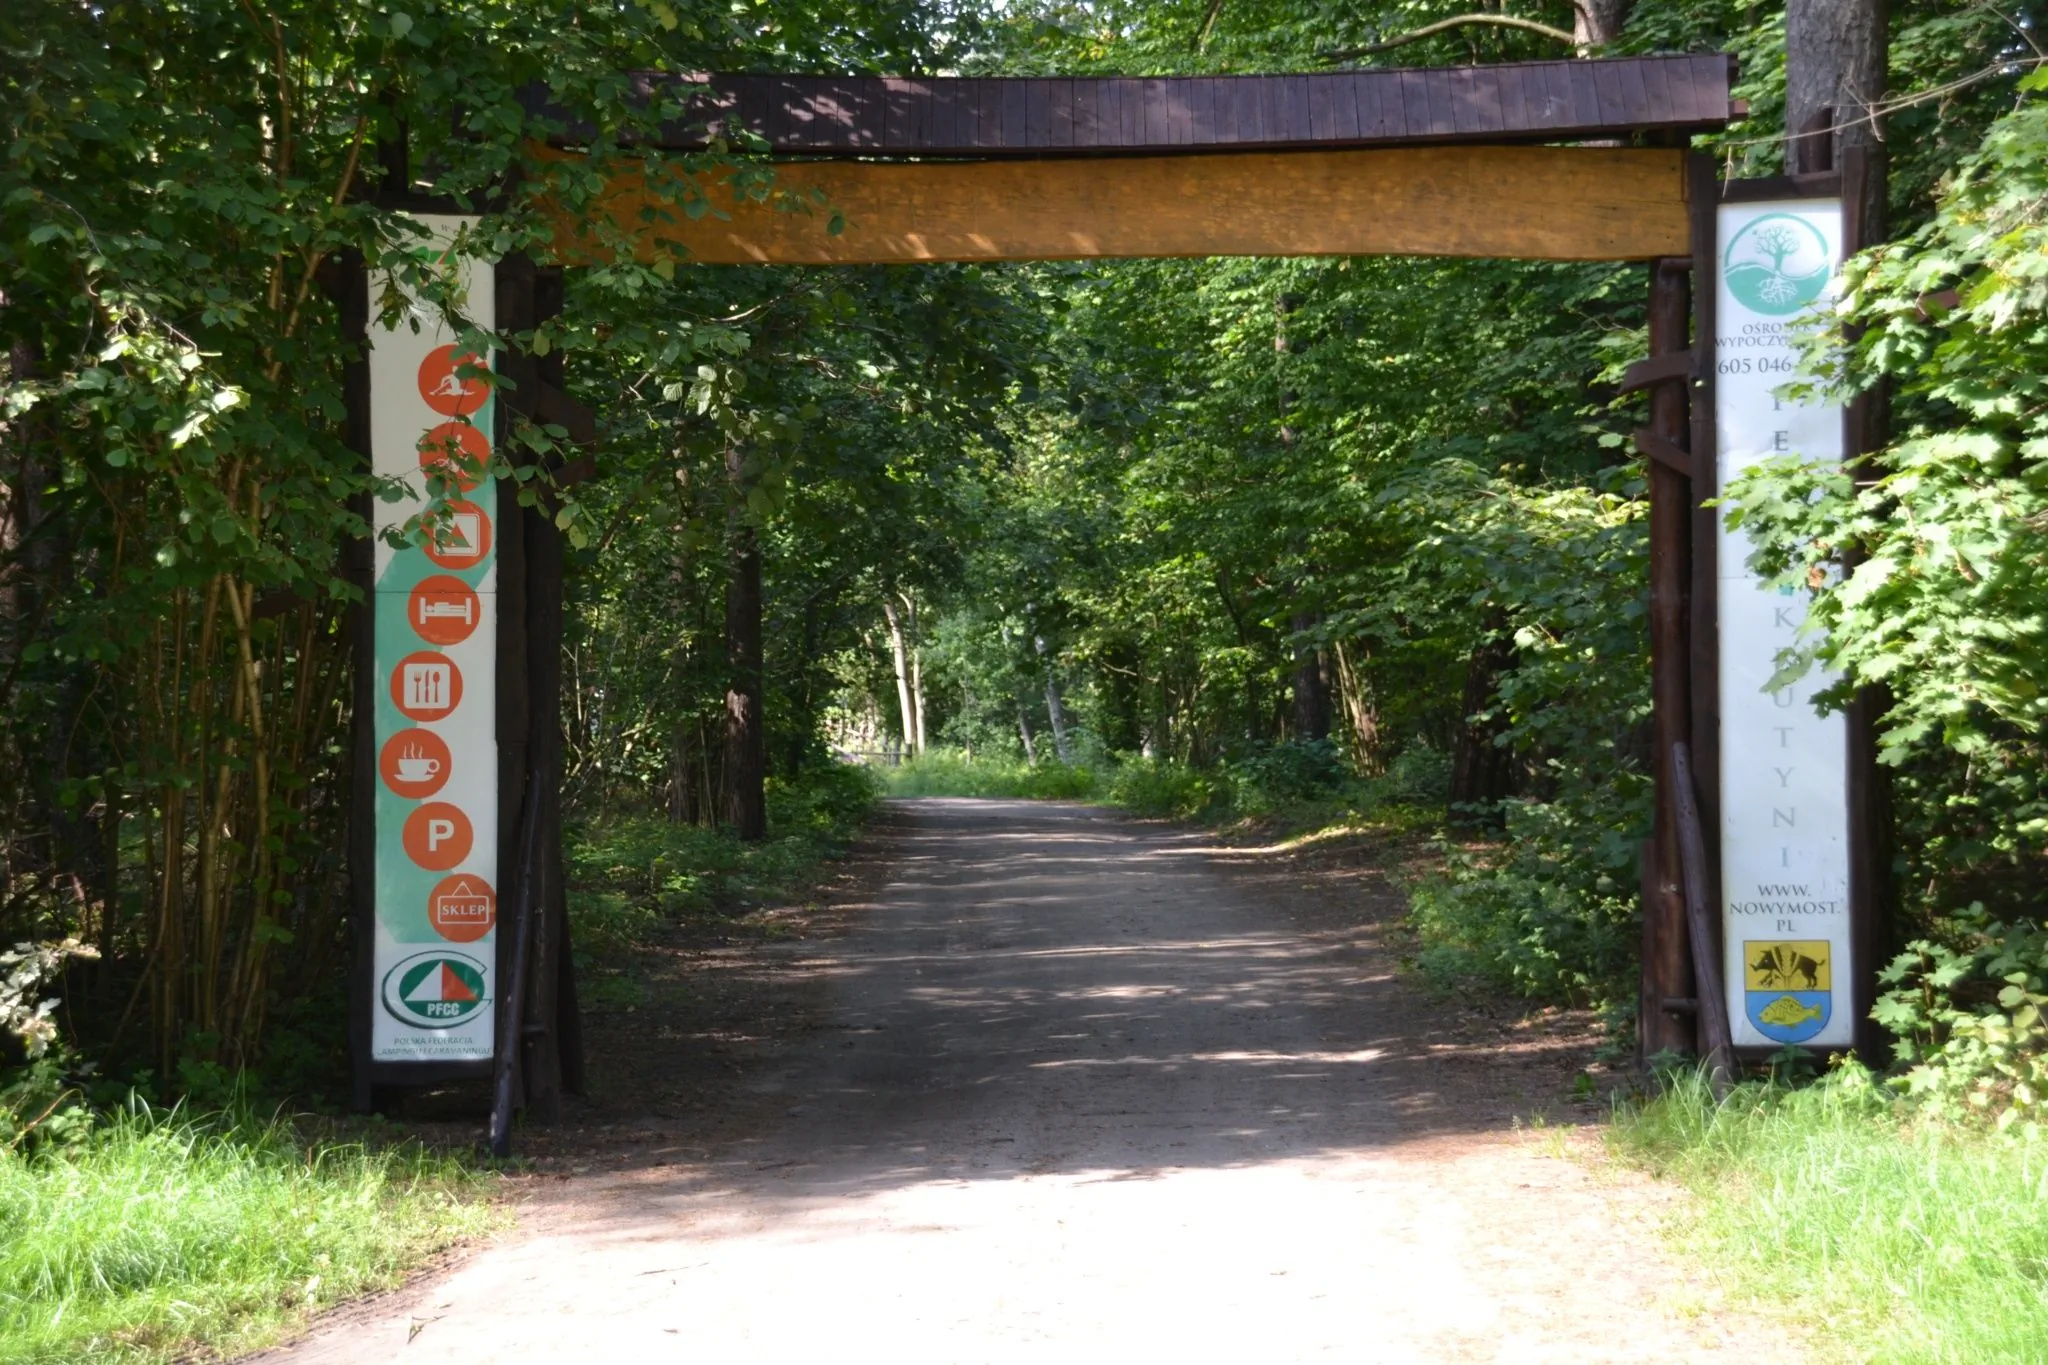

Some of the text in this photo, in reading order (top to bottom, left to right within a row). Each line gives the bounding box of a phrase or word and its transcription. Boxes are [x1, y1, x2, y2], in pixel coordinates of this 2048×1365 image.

[1742, 321, 1813, 335] OŚROK
[1718, 357, 1752, 375] 605
[1758, 355, 1792, 374] 046
[428, 819, 455, 852] P
[442, 904, 486, 916] SKLEP
[1729, 901, 1841, 915] NOWYMOST.
[1776, 919, 1797, 932] PL
[427, 1002, 460, 1016] PFCC
